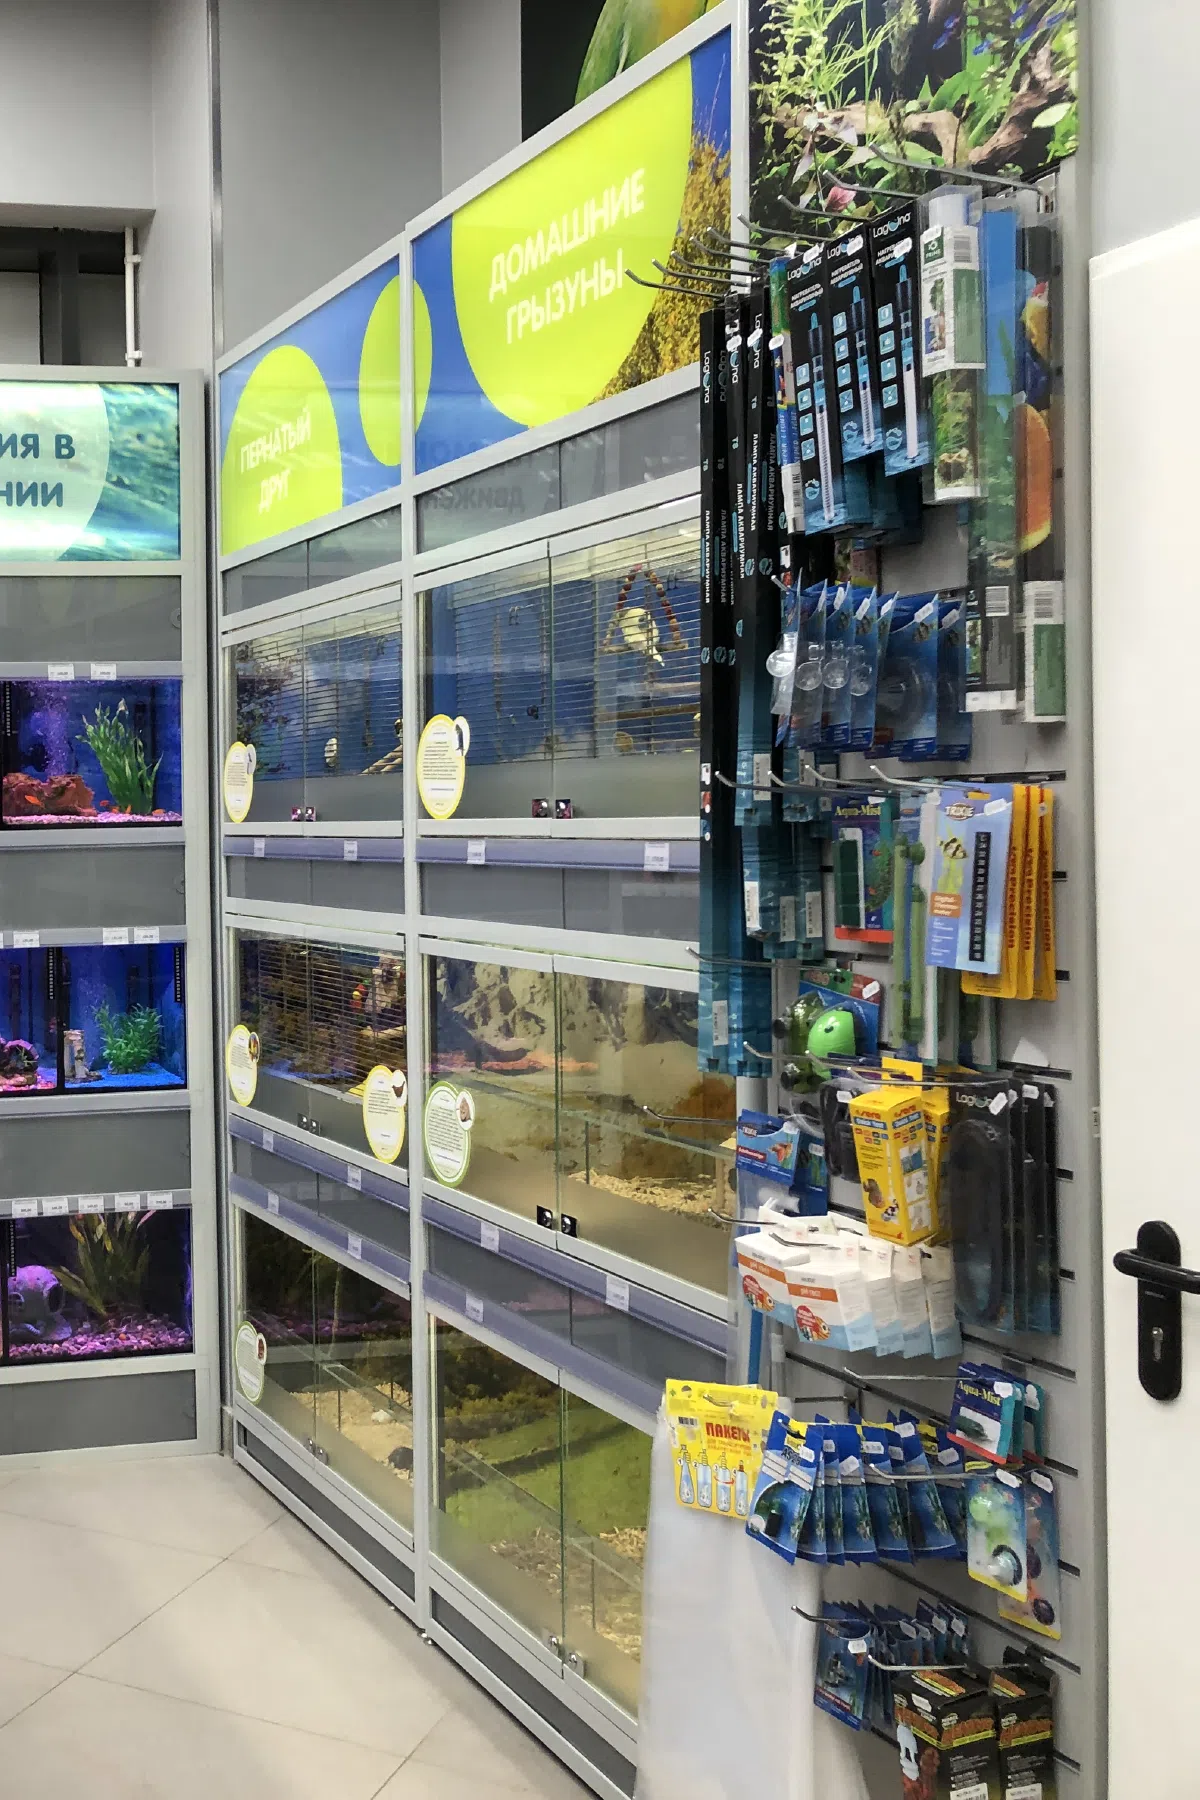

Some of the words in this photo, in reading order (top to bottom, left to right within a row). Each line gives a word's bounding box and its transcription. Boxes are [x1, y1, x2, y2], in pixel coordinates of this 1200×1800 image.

[489, 168, 646, 303] ДОМАШНИЕ
[505, 248, 624, 344] ГРЫЗУНЫ
[54, 432, 77, 460] в
[240, 406, 312, 475] ПЕРНАТЫЙ
[257, 468, 293, 515] ДРУГ
[736, 483, 744, 514] ЛАМПА
[750, 466, 758, 531] АКВАРИУМНАЯ
[767, 465, 775, 531] АКВАРИУМНАЯ
[835, 804, 881, 819] Aqua-Mist
[944, 805, 975, 818] TRIXIE
[860, 1110, 881, 1120] sera
[898, 1105, 917, 1117] sera
[957, 1381, 1001, 1406] Aqua-Mist
[705, 1422, 750, 1443] ПАКЕТЫ
